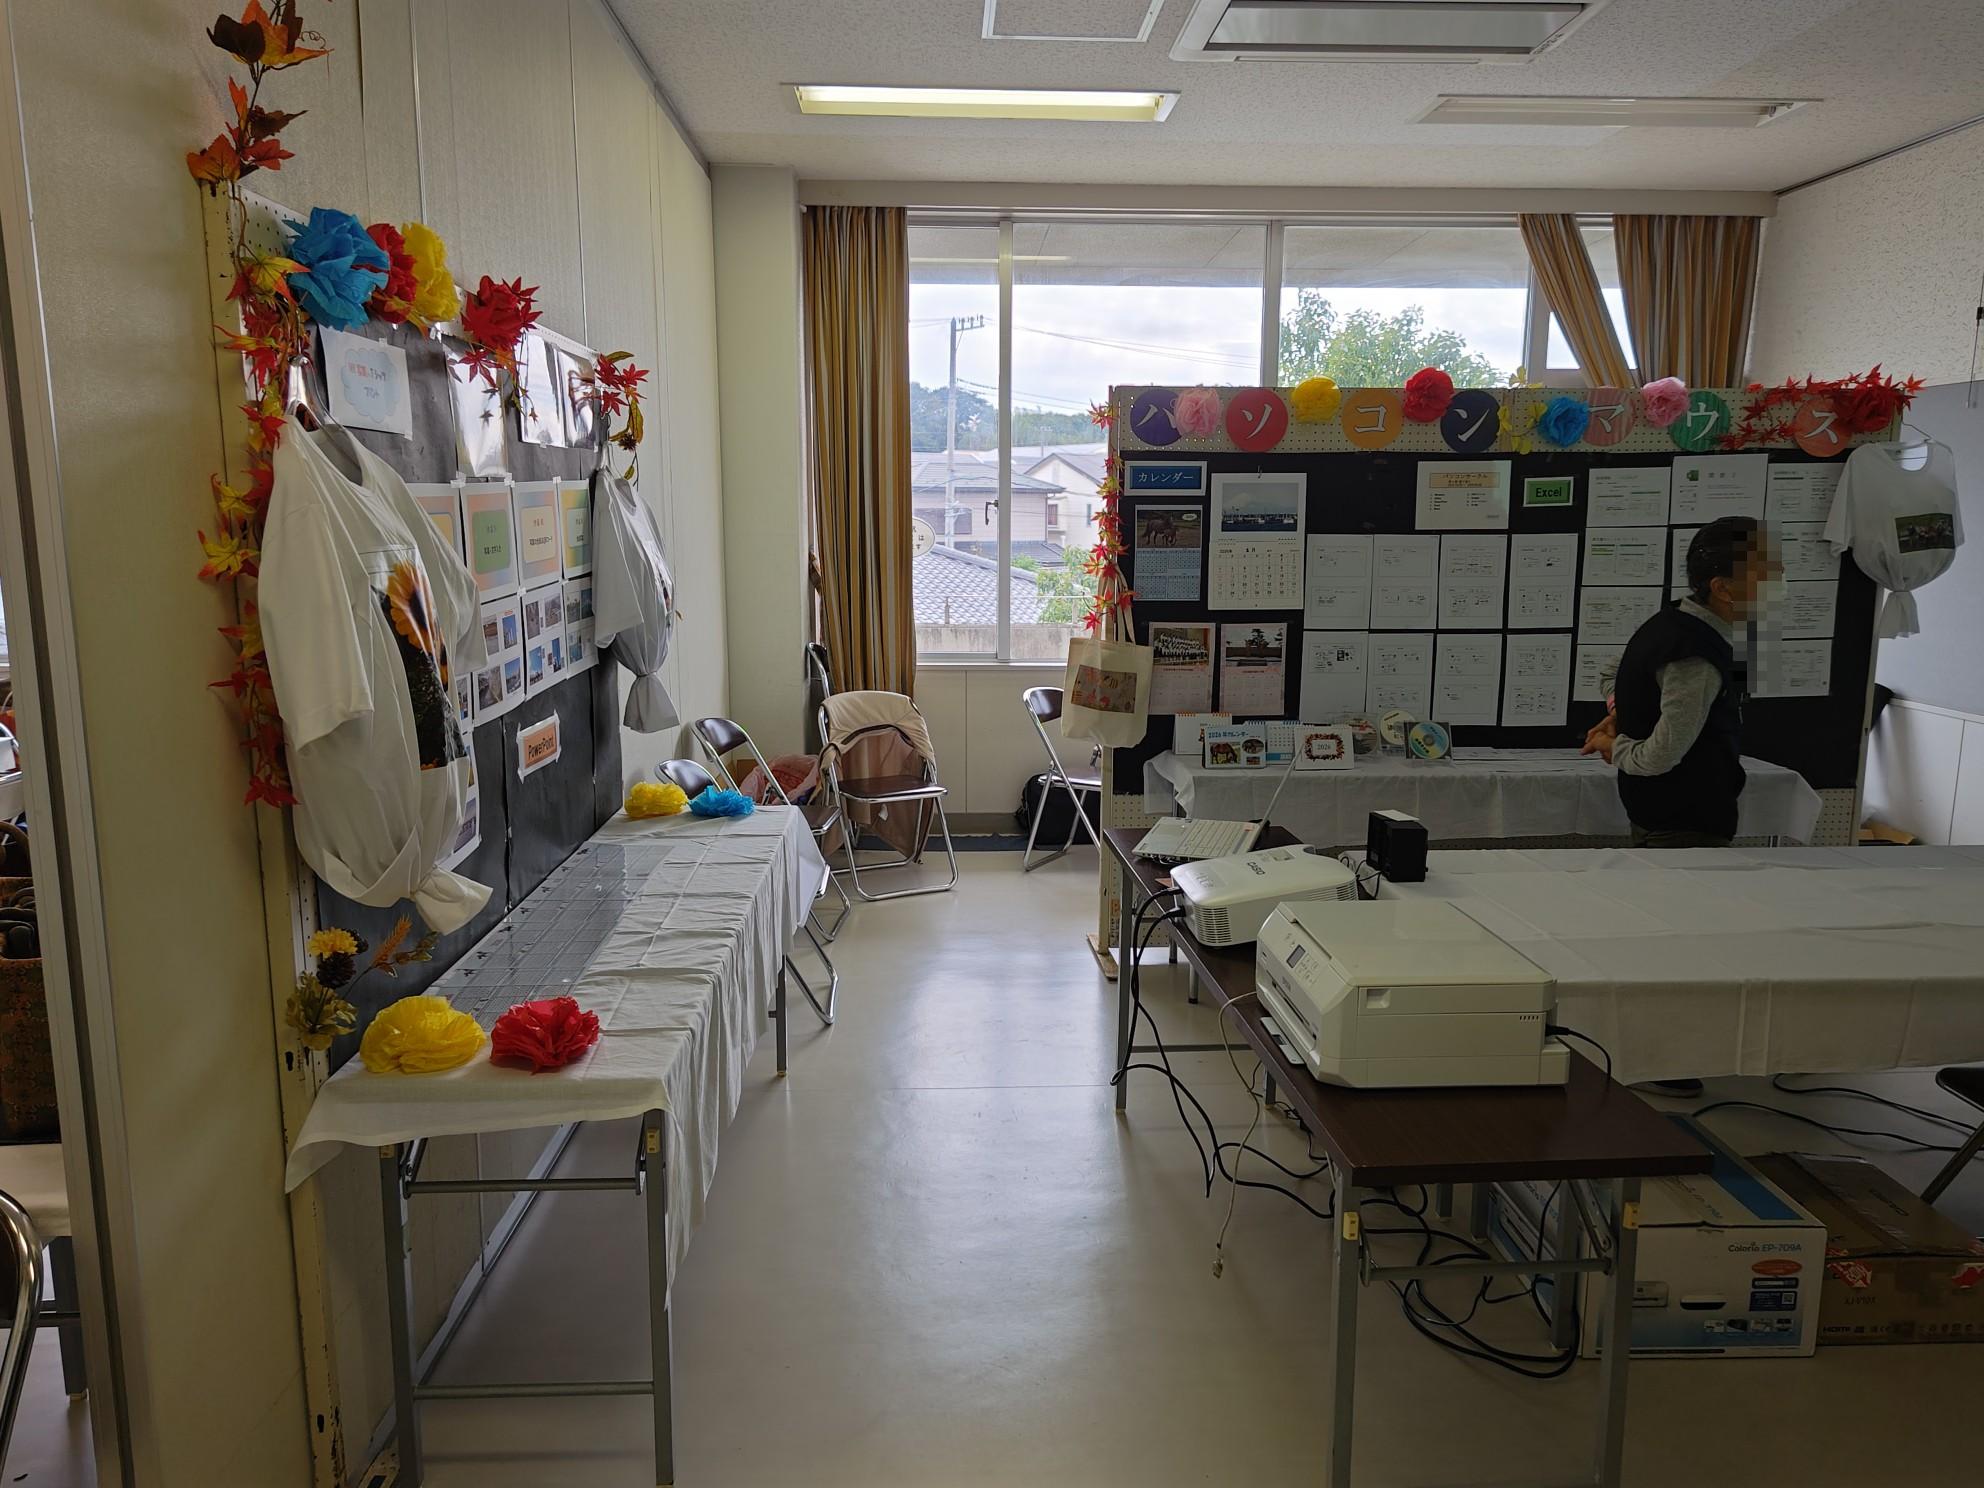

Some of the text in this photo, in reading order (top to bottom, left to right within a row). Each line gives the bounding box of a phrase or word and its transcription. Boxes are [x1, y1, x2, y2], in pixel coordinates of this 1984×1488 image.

[1137, 471, 1193, 483] カレンダー
[1536, 487, 1562, 498] Excel
[528, 736, 554, 760] PowerPoint
[1728, 1241, 1802, 1252] Colorio EP-709A
